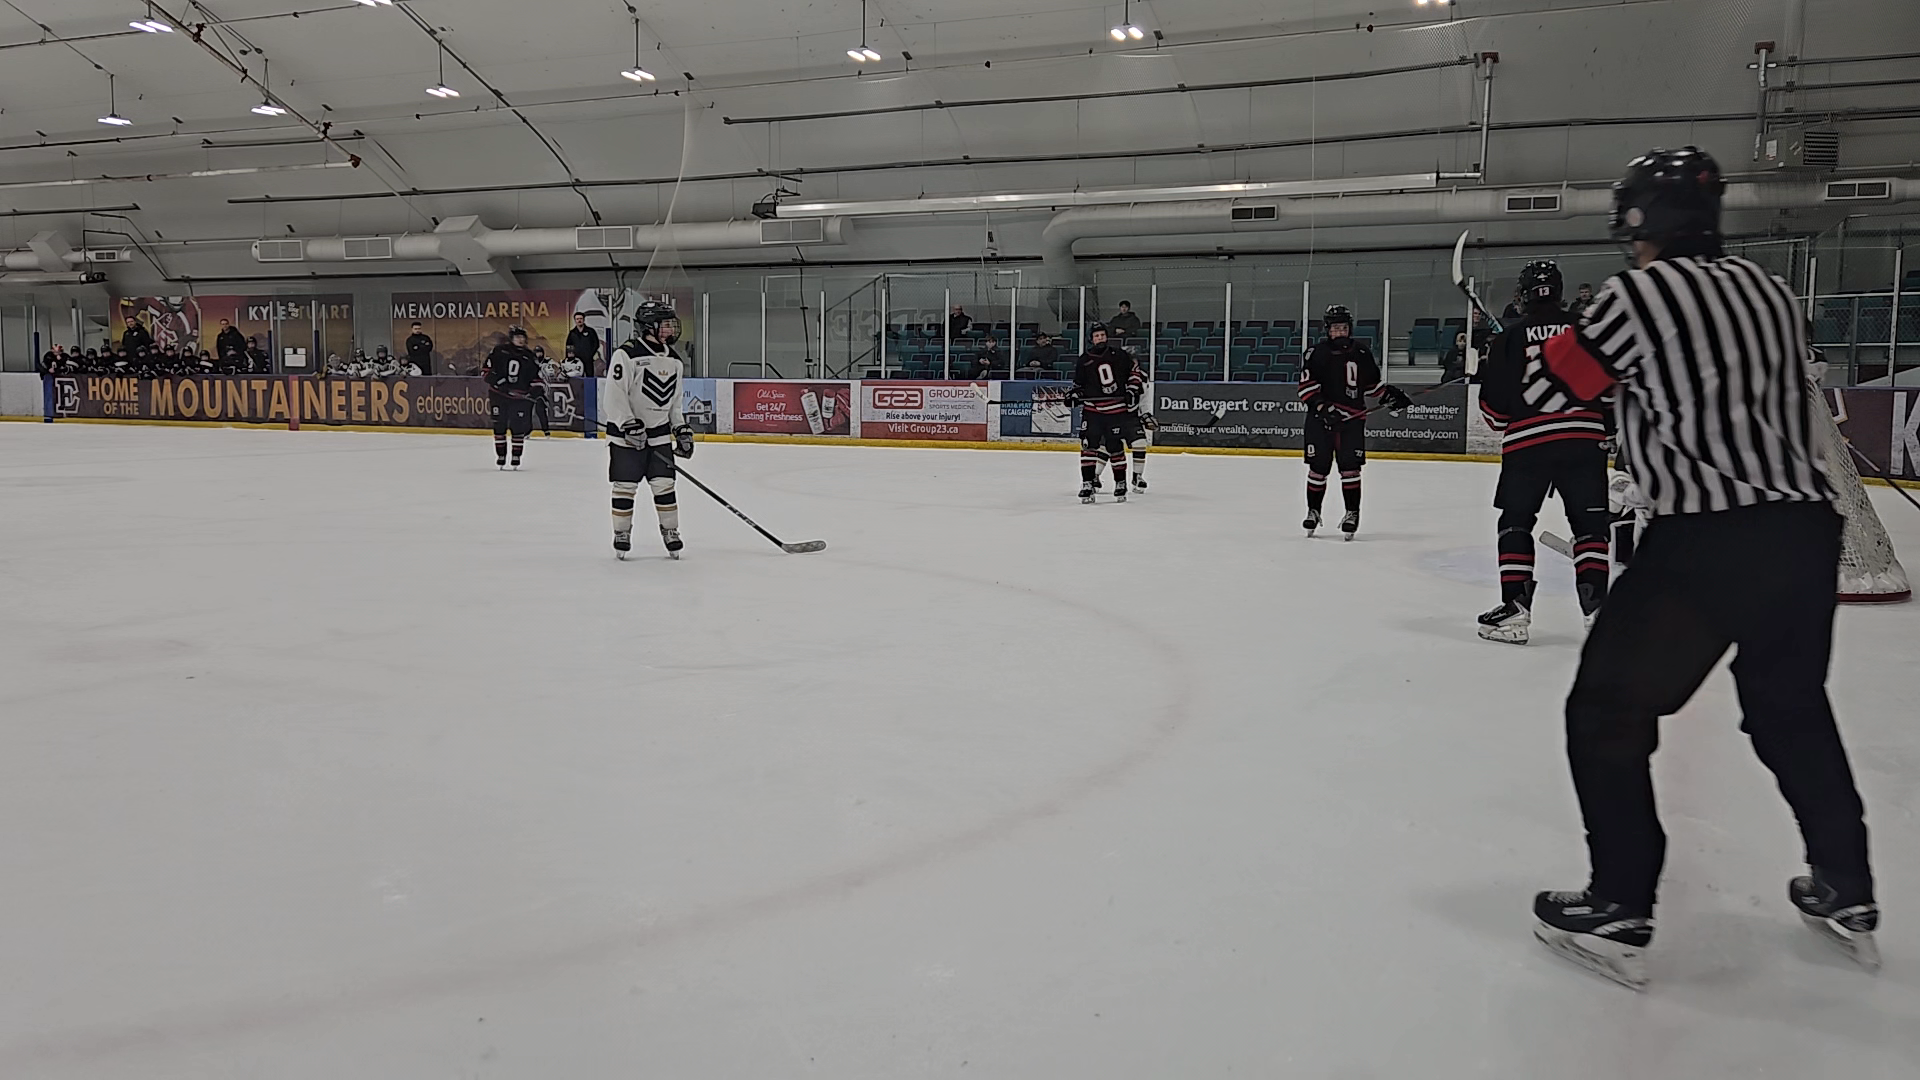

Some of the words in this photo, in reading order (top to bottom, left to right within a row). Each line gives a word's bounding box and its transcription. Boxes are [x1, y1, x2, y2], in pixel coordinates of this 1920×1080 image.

[1538, 287, 1550, 296] 13
[613, 363, 624, 380] 9
[88, 377, 139, 401] HOME
[928, 389, 976, 399] GROUP23
[150, 379, 410, 423] MOUNTAINEERS
[874, 390, 921, 407] G23
[104, 402, 118, 415] OF
[120, 402, 139, 415] THE
[756, 402, 769, 411] Get
[770, 403, 786, 412] 24/7
[1008, 408, 1032, 416] CALGARY
[1160, 397, 1189, 410] Dan
[1193, 397, 1249, 415] Beyaert
[1407, 405, 1459, 414] Bellwether
[738, 412, 764, 422] Lasting
[765, 412, 803, 422] Freshness
[886, 411, 900, 420] Rise
[901, 411, 921, 420] above
[922, 413, 937, 422] your
[939, 412, 961, 422] injury!
[888, 423, 908, 433] Visit
[910, 424, 959, 435] Group23.ca
[1196, 426, 1216, 435] your
[1218, 425, 1250, 435] wealth,
[1251, 426, 1288, 437] securing
